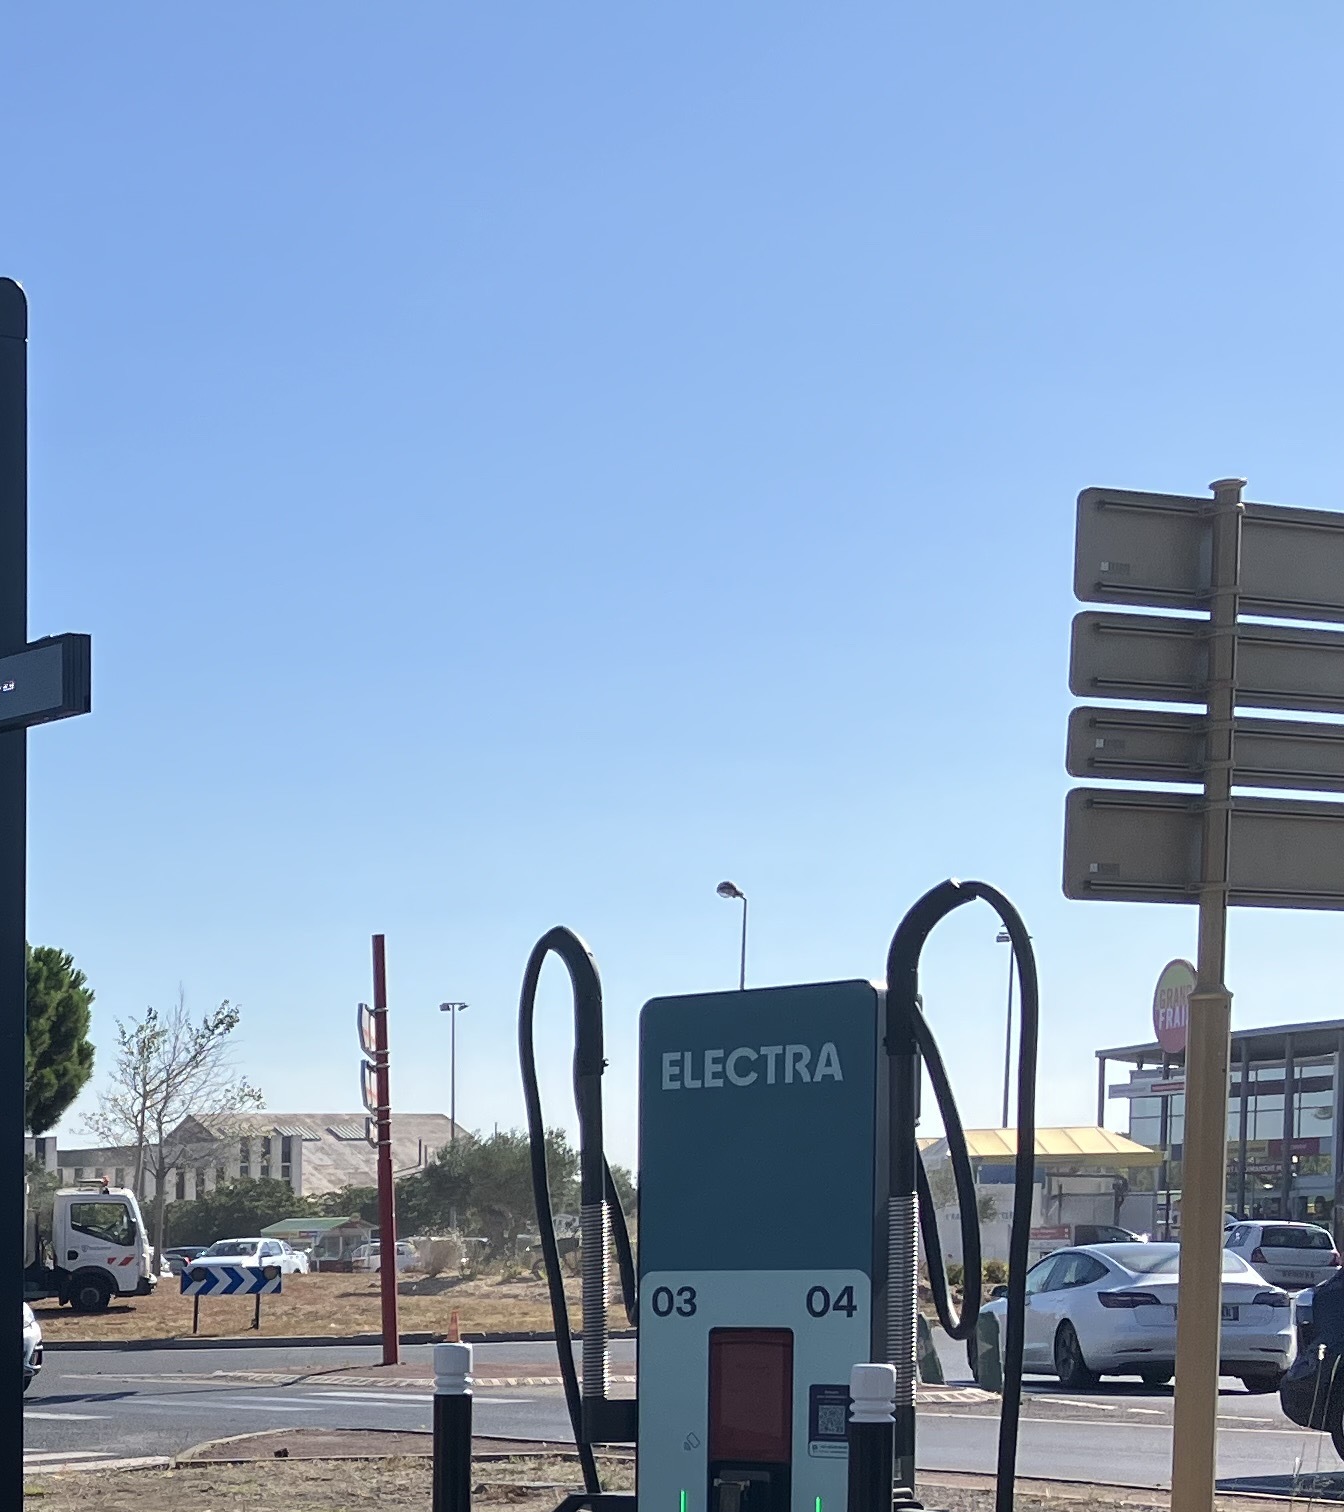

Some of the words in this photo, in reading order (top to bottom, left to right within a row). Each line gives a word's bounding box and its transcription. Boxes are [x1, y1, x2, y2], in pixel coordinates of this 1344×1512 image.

[1159, 1006, 1187, 1031] FRAI
[661, 1042, 844, 1091] ELECTRA
[652, 1285, 697, 1318] 03
[806, 1285, 858, 1319] 04
